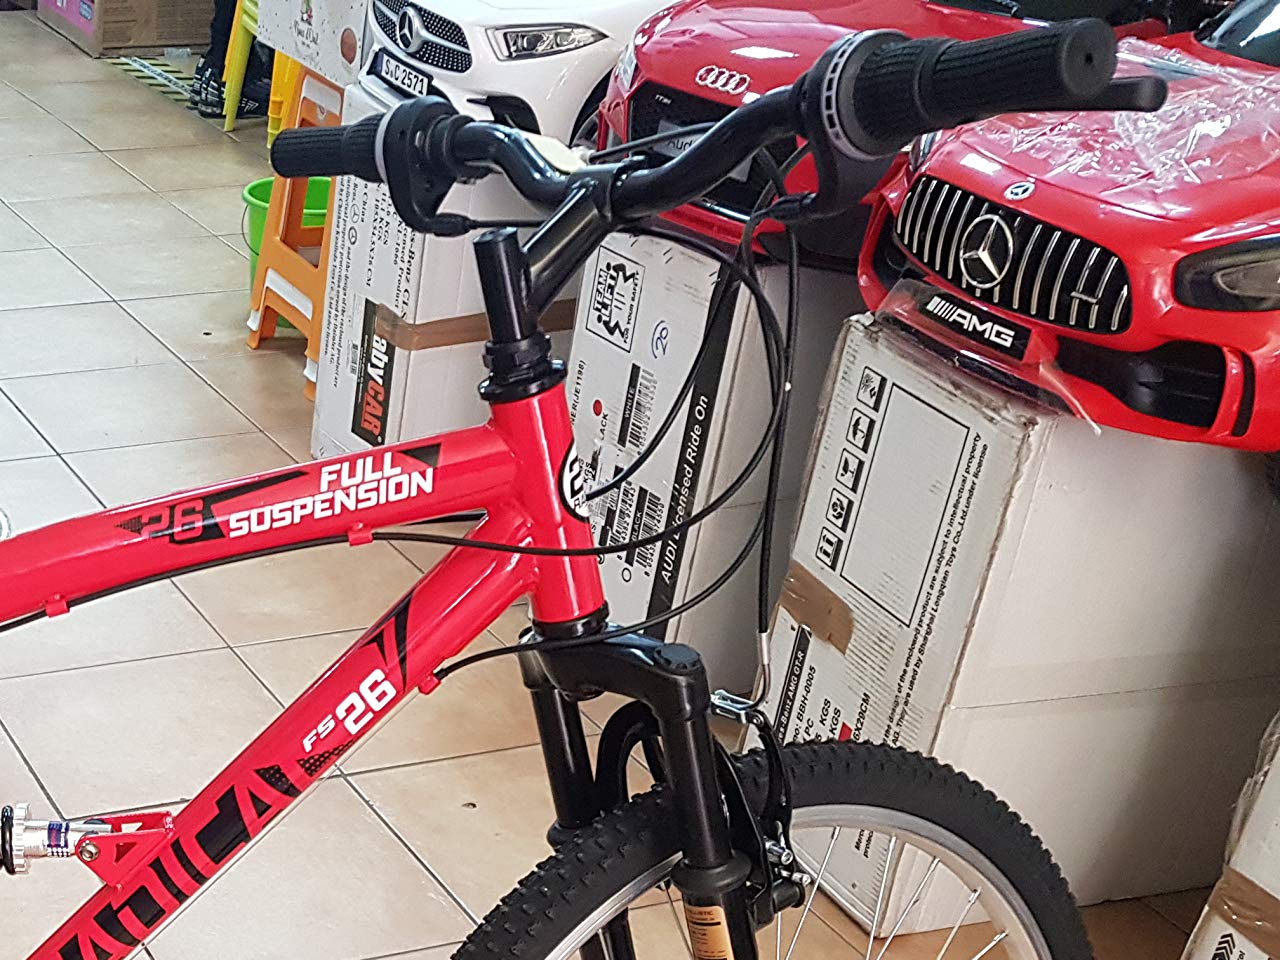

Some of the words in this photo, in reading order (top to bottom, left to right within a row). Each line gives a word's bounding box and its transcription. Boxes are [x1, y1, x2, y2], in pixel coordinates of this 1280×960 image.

[401, 69, 425, 95] 2571
[593, 269, 607, 311] TEAM
[600, 272, 617, 316] LIFT
[360, 334, 388, 435] abyCAR
[624, 386, 635, 419] WHITE
[963, 432, 982, 474] property
[972, 443, 988, 479] license
[320, 451, 402, 493] FULL
[659, 539, 678, 584] AUDI
[684, 423, 703, 464] Ride
[695, 394, 709, 420] On
[228, 467, 435, 539] SUSPENSION
[946, 474, 967, 527] intellectual
[943, 528, 951, 538] to
[932, 539, 949, 574] subject
[944, 545, 958, 569] Toys
[927, 575, 937, 590] are
[916, 591, 931, 627] product
[903, 627, 921, 667] enclosed
[917, 612, 936, 655] Shanghai
[898, 667, 907, 682] the
[907, 668, 918, 691] used
[914, 656, 923, 668] by
[786, 673, 799, 699] AMG
[795, 664, 816, 722] BBH-0005
[895, 682, 903, 693] of
[903, 691, 911, 706] are
[301, 713, 337, 753] FS
[334, 668, 398, 736] 26
[817, 698, 832, 726] KGS
[827, 706, 842, 735] KGS
[852, 692, 871, 740] 6X29CM
[862, 830, 874, 858] protec
